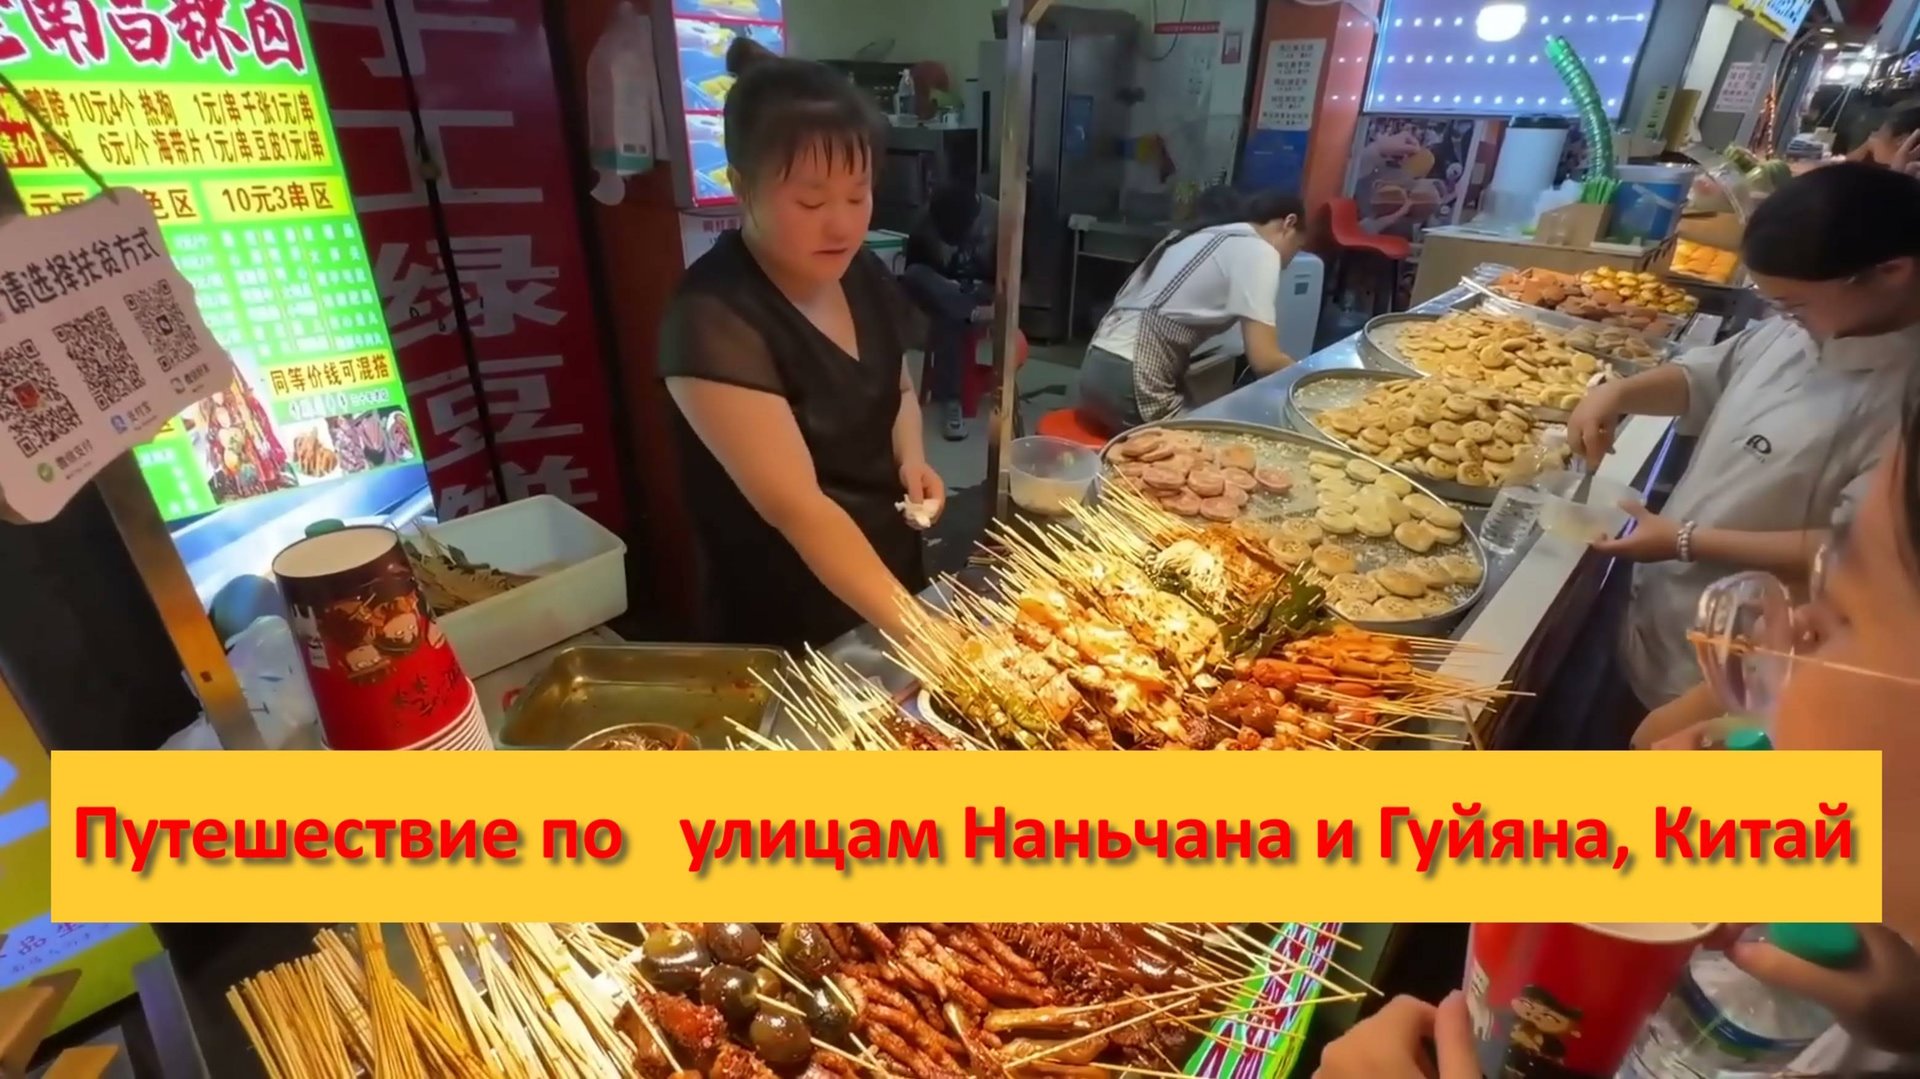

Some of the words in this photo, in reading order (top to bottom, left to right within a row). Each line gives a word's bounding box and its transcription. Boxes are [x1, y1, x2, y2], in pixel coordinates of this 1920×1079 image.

[222, 181, 333, 213] 10元3串区
[0, 226, 160, 314] 请选择扶贫方式
[270, 353, 390, 395] 同等价钱可混搭
